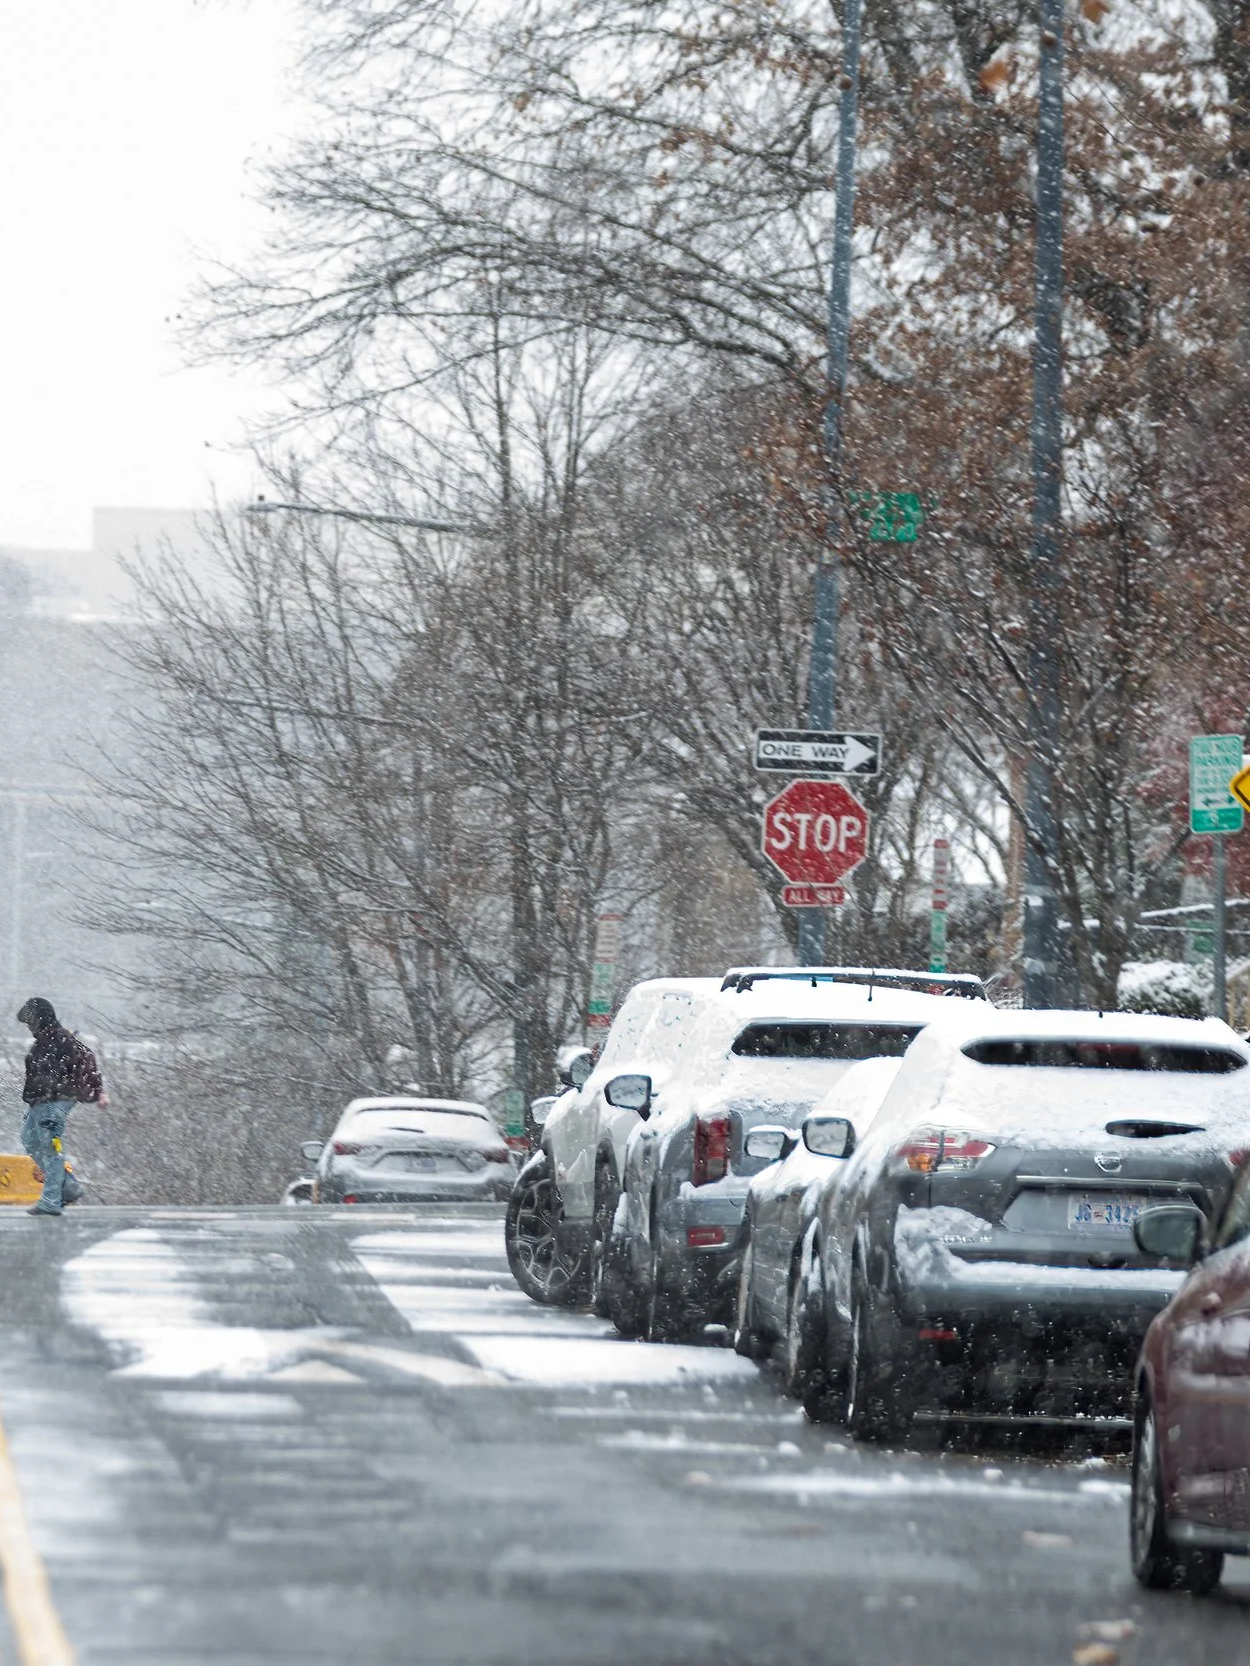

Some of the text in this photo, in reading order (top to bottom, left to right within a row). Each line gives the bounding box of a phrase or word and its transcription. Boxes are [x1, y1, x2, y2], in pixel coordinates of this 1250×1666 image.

[762, 743, 849, 758] ONE WAY
[769, 812, 862, 853] STOP
[788, 889, 810, 901] ALL
